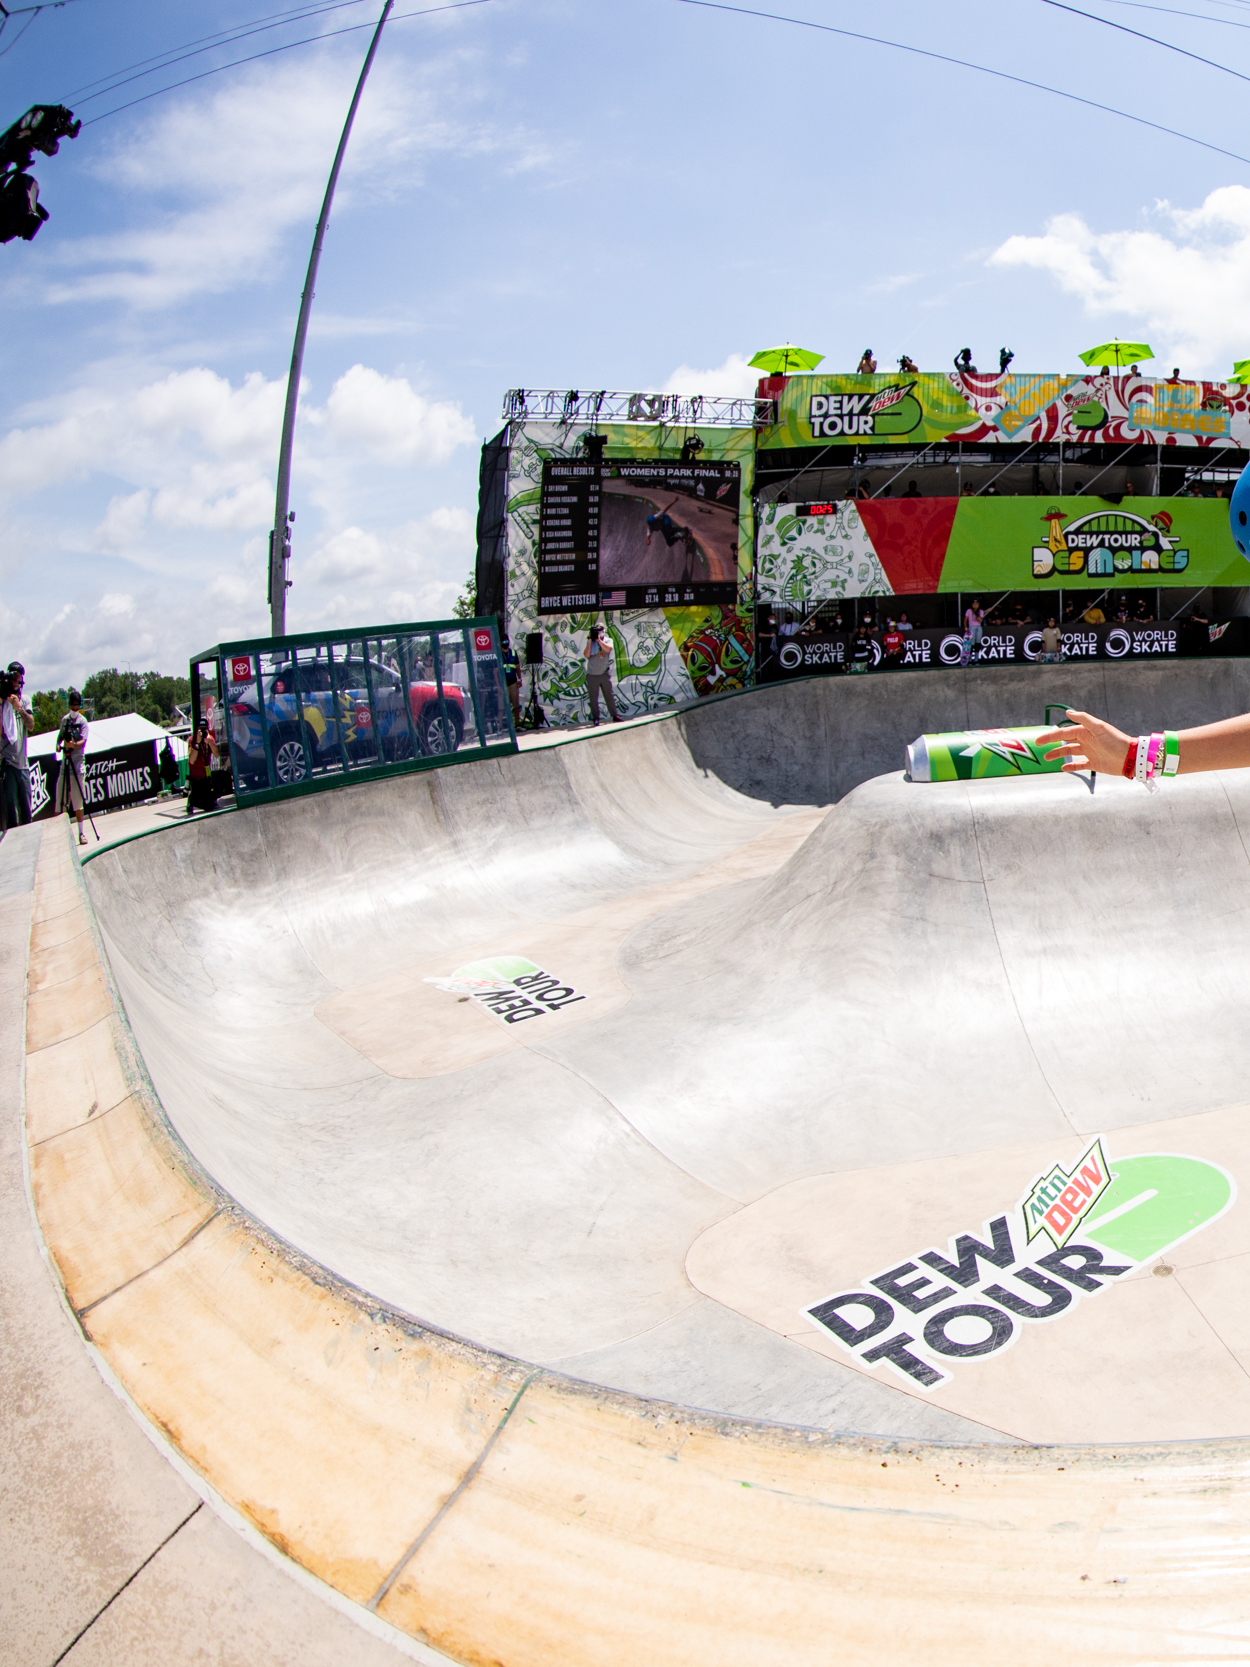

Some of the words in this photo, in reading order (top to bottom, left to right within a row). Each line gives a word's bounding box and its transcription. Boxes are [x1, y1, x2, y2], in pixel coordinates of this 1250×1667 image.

[811, 395, 870, 415] DEW
[811, 415, 873, 437] TOUR
[551, 467, 572, 476] OVERALL
[573, 467, 595, 476] RESULTS
[620, 468, 666, 476] WOMEN'S
[667, 468, 693, 476] PARK
[694, 469, 721, 477] FINAL
[1033, 547, 1084, 576] DES
[1087, 548, 1188, 574] MOINES
[541, 596, 560, 607] BRYCE
[561, 594, 596, 606] WETTSTEIN
[980, 636, 1015, 647] ORLD
[1133, 631, 1177, 642] WORLD
[804, 642, 844, 653] WORLD
[903, 639, 931, 650] RLD
[1061, 643, 1098, 655] KATE
[1133, 640, 1177, 653] SKATE
[473, 653, 498, 662] TOYOTA
[804, 652, 844, 665] SKATE
[901, 651, 931, 663] ATE
[978, 647, 1015, 659] KATE
[229, 685, 250, 696] TOYOT
[84, 778, 105, 805] DES
[107, 766, 152, 798] MOINES
[512, 971, 587, 1011] TOUR
[473, 989, 547, 1024] DEW
[807, 1215, 1016, 1348] DEW
[860, 1244, 1133, 1387] TOUR
